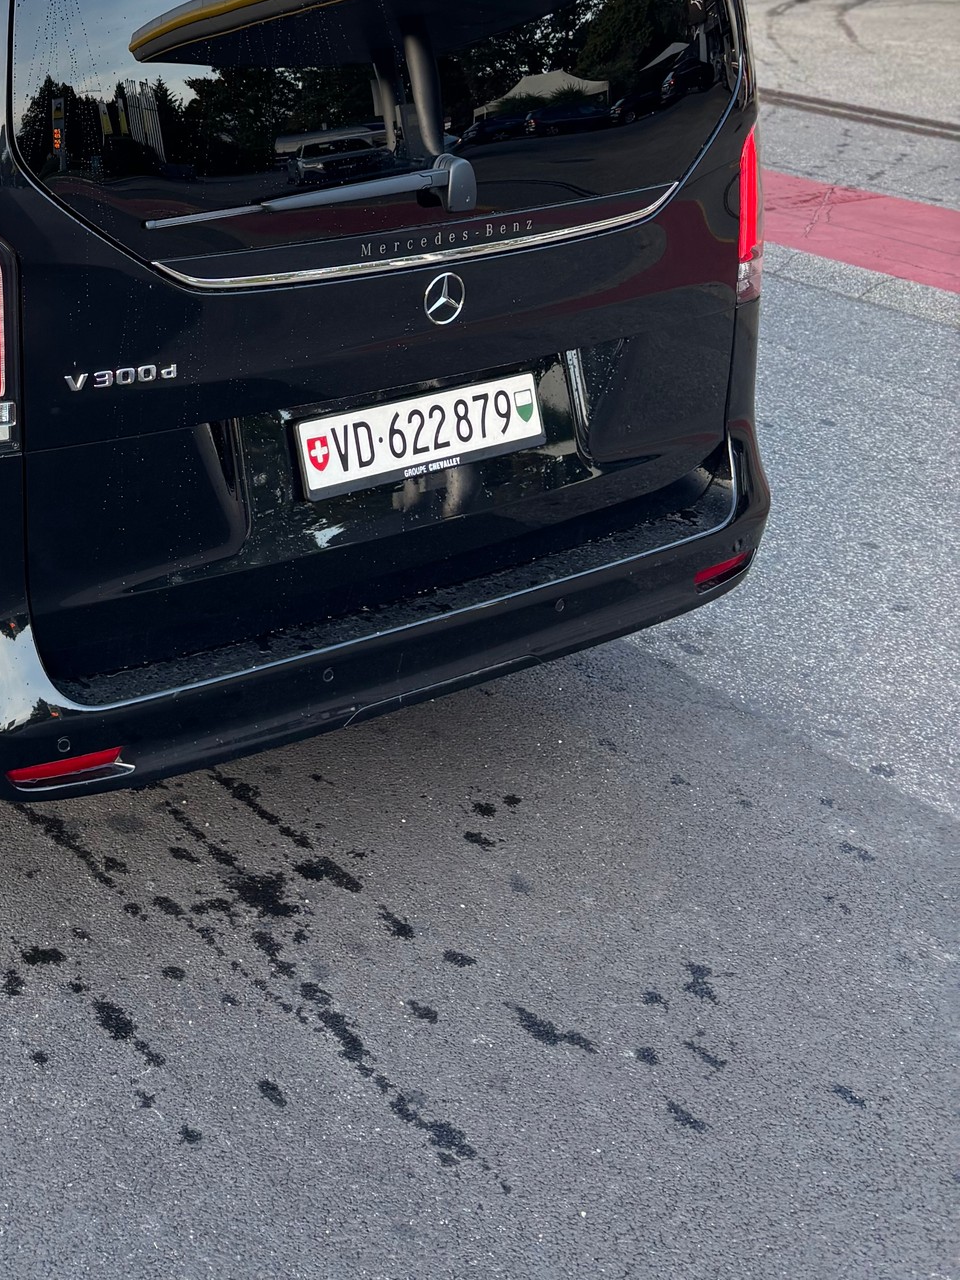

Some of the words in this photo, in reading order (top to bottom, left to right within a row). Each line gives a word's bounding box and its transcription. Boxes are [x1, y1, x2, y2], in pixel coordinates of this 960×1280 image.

[360, 219, 533, 257] Mercedes-Benz
[63, 373, 89, 392] V
[404, 464, 428, 478] GROUPE
[428, 456, 461, 472] CHEVALLEY
